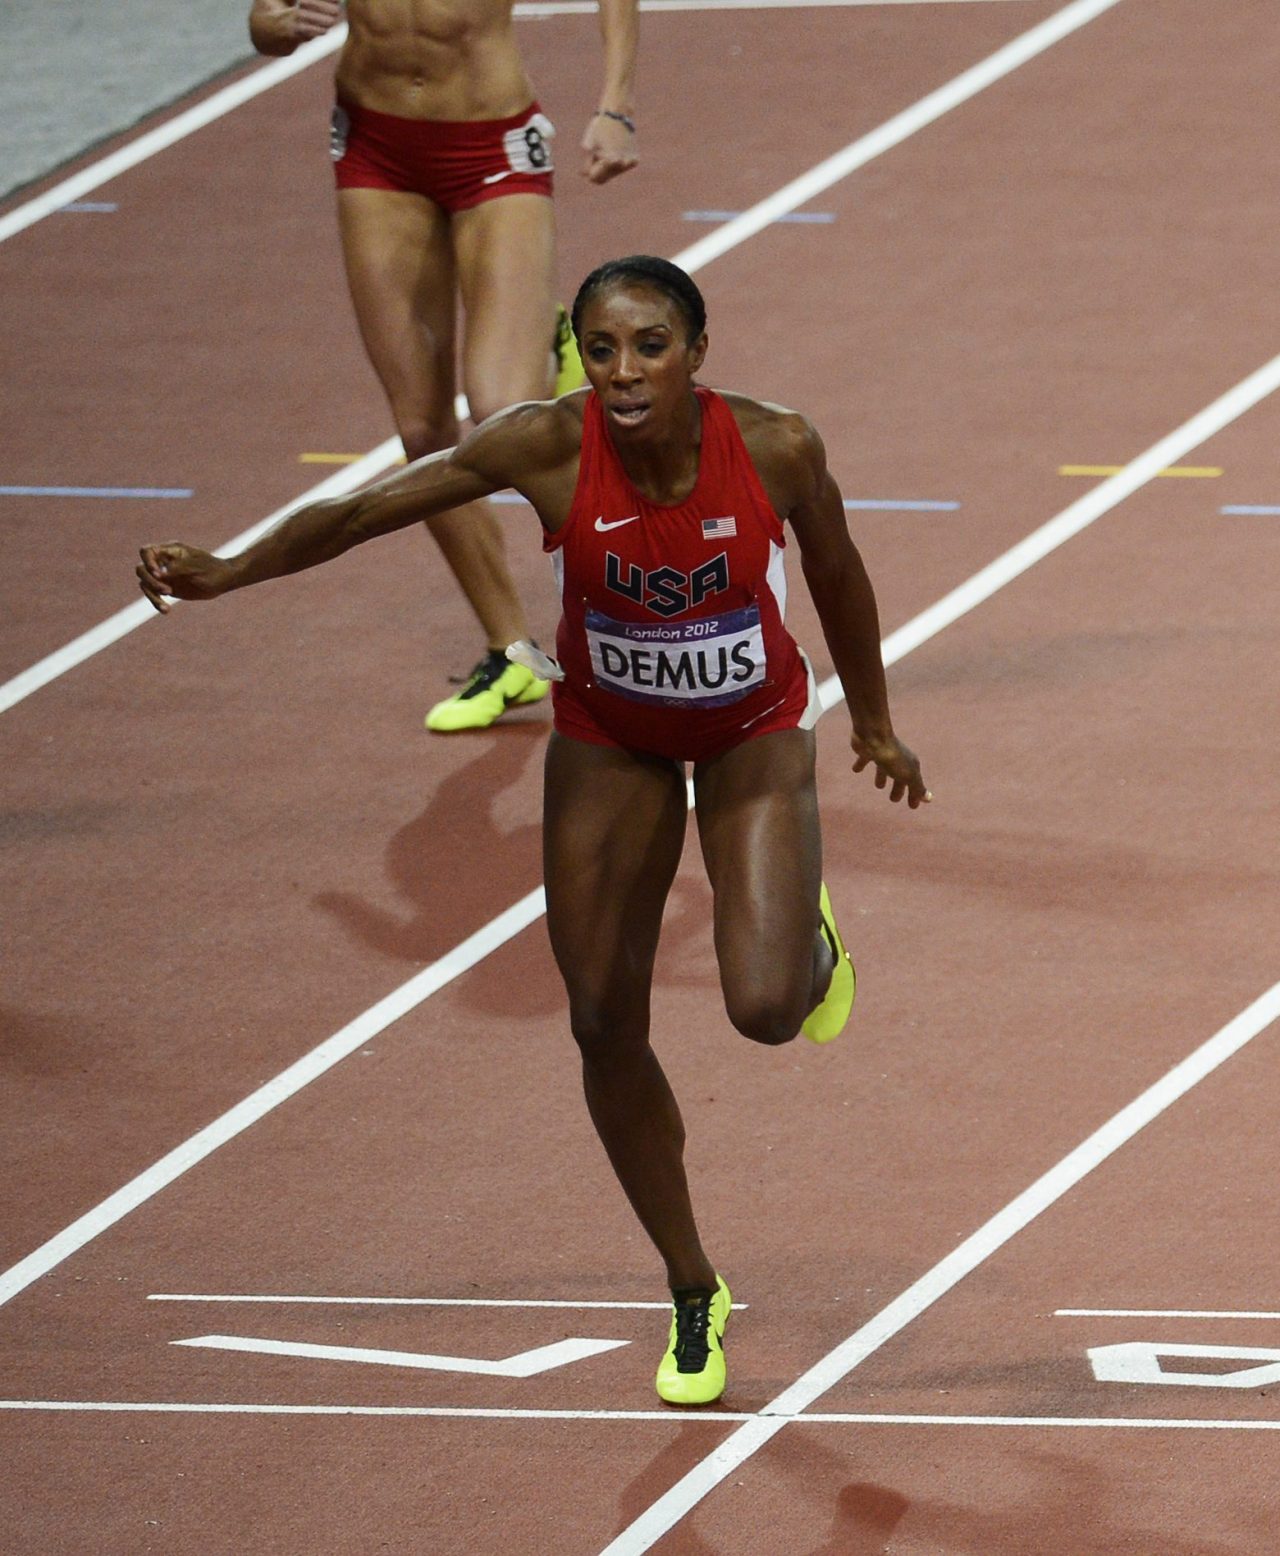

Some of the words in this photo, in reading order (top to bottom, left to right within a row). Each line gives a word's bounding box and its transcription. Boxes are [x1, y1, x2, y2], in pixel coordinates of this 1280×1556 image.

[524, 126, 546, 168] 8
[605, 551, 730, 618] USA
[625, 626, 680, 640] London
[684, 621, 719, 638] 2012
[599, 640, 755, 691] DEMUS
